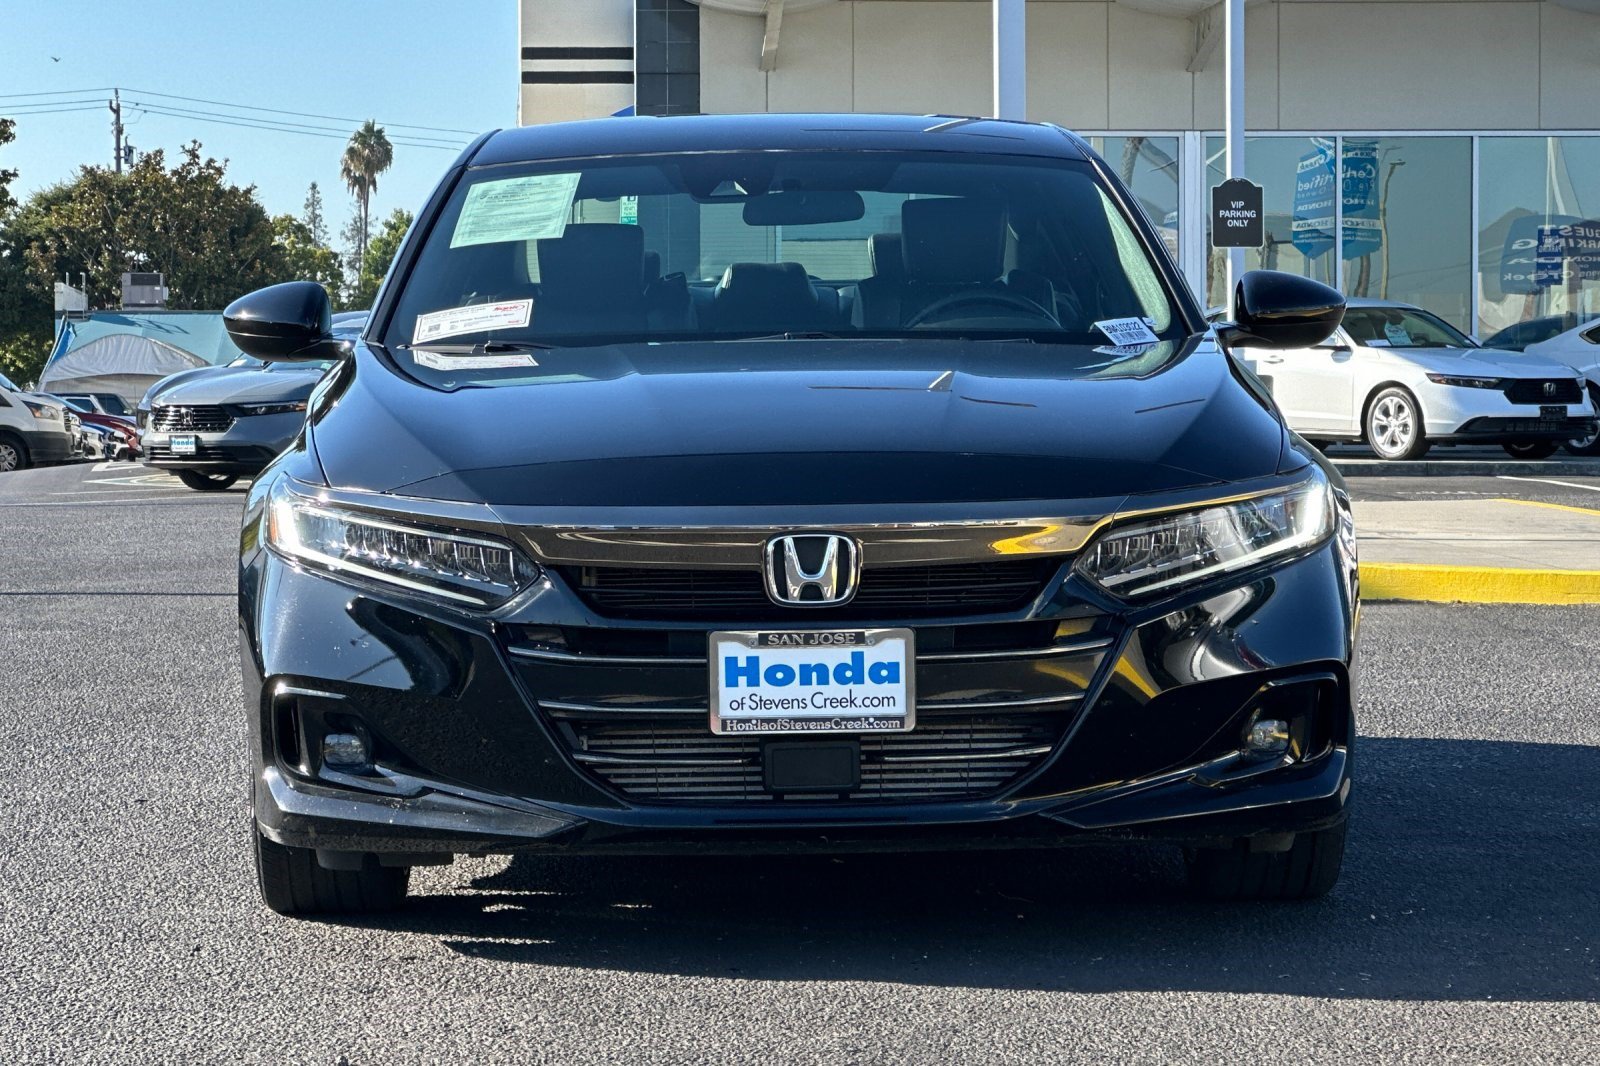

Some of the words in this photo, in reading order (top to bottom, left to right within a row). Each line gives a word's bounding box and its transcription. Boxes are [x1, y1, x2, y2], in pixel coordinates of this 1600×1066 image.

[1230, 200, 1245, 209] VIP
[1219, 210, 1257, 218] PARKING
[1227, 219, 1249, 227] ONLY
[768, 634, 805, 645] SAN
[810, 633, 856, 645] JOSE
[724, 651, 901, 688] Honda
[729, 697, 747, 711] of
[748, 693, 808, 710] Stevens
[811, 689, 896, 709] Creek.com
[726, 717, 900, 732] HondaofStevensCreek.com
